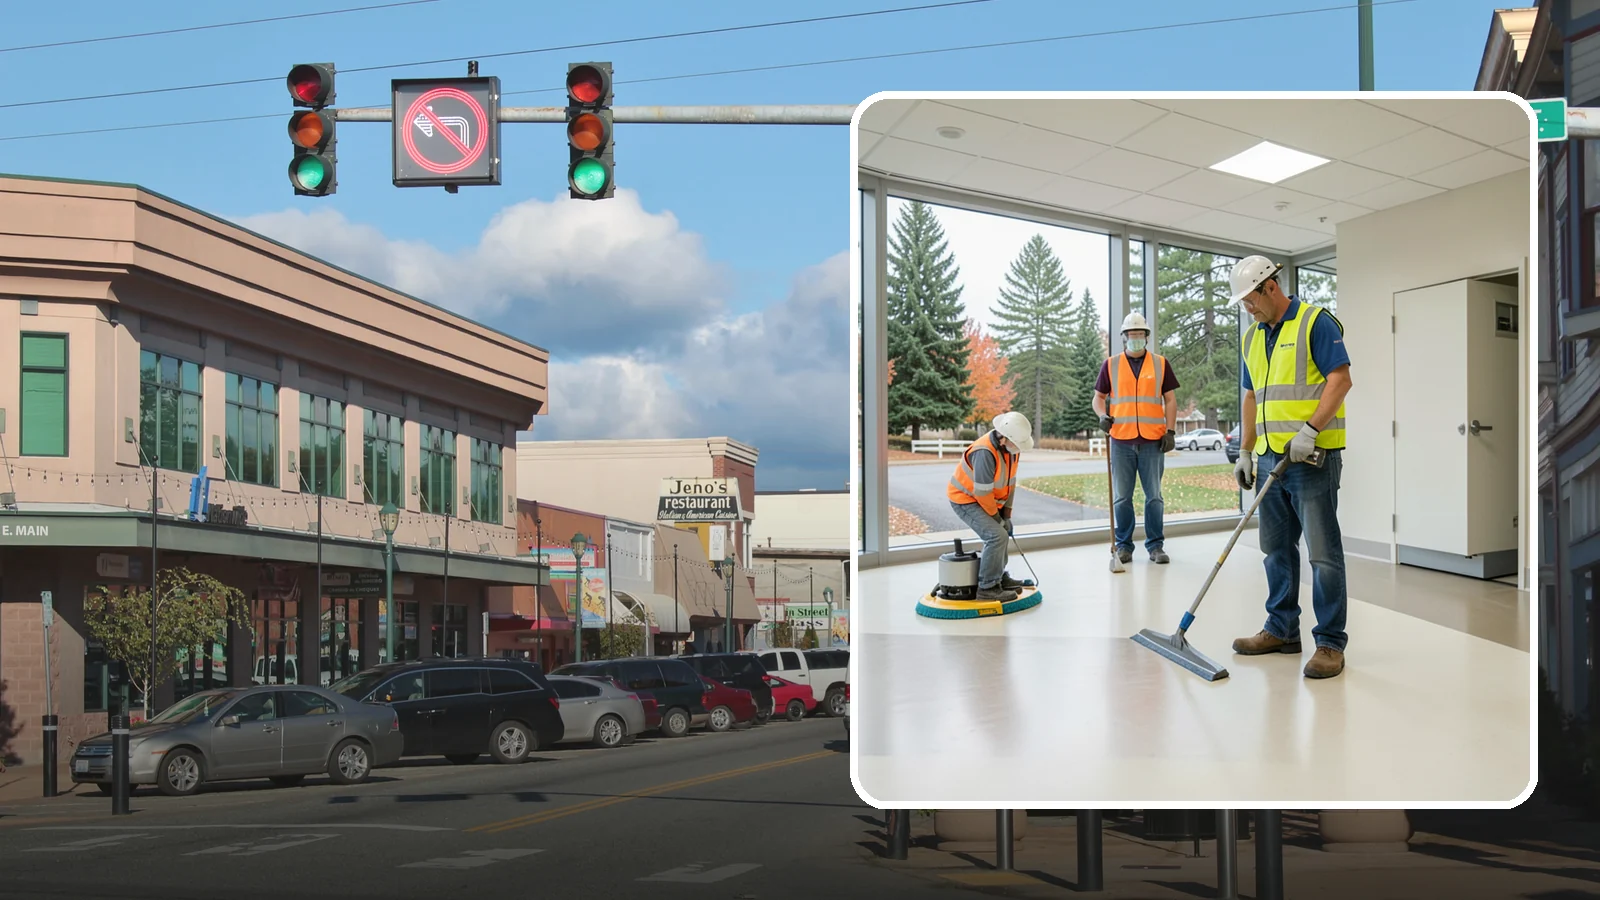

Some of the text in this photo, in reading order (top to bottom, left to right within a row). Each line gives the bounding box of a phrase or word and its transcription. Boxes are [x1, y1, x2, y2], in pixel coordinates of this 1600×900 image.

[669, 479, 728, 495] Jeno's
[665, 496, 731, 509] restaurant
[659, 509, 681, 519] Italian
[686, 509, 714, 519] American
[715, 509, 738, 519] Cuisine
[2, 525, 49, 536] E. MAIN
[797, 607, 828, 616] Street
[790, 619, 824, 627] lass
